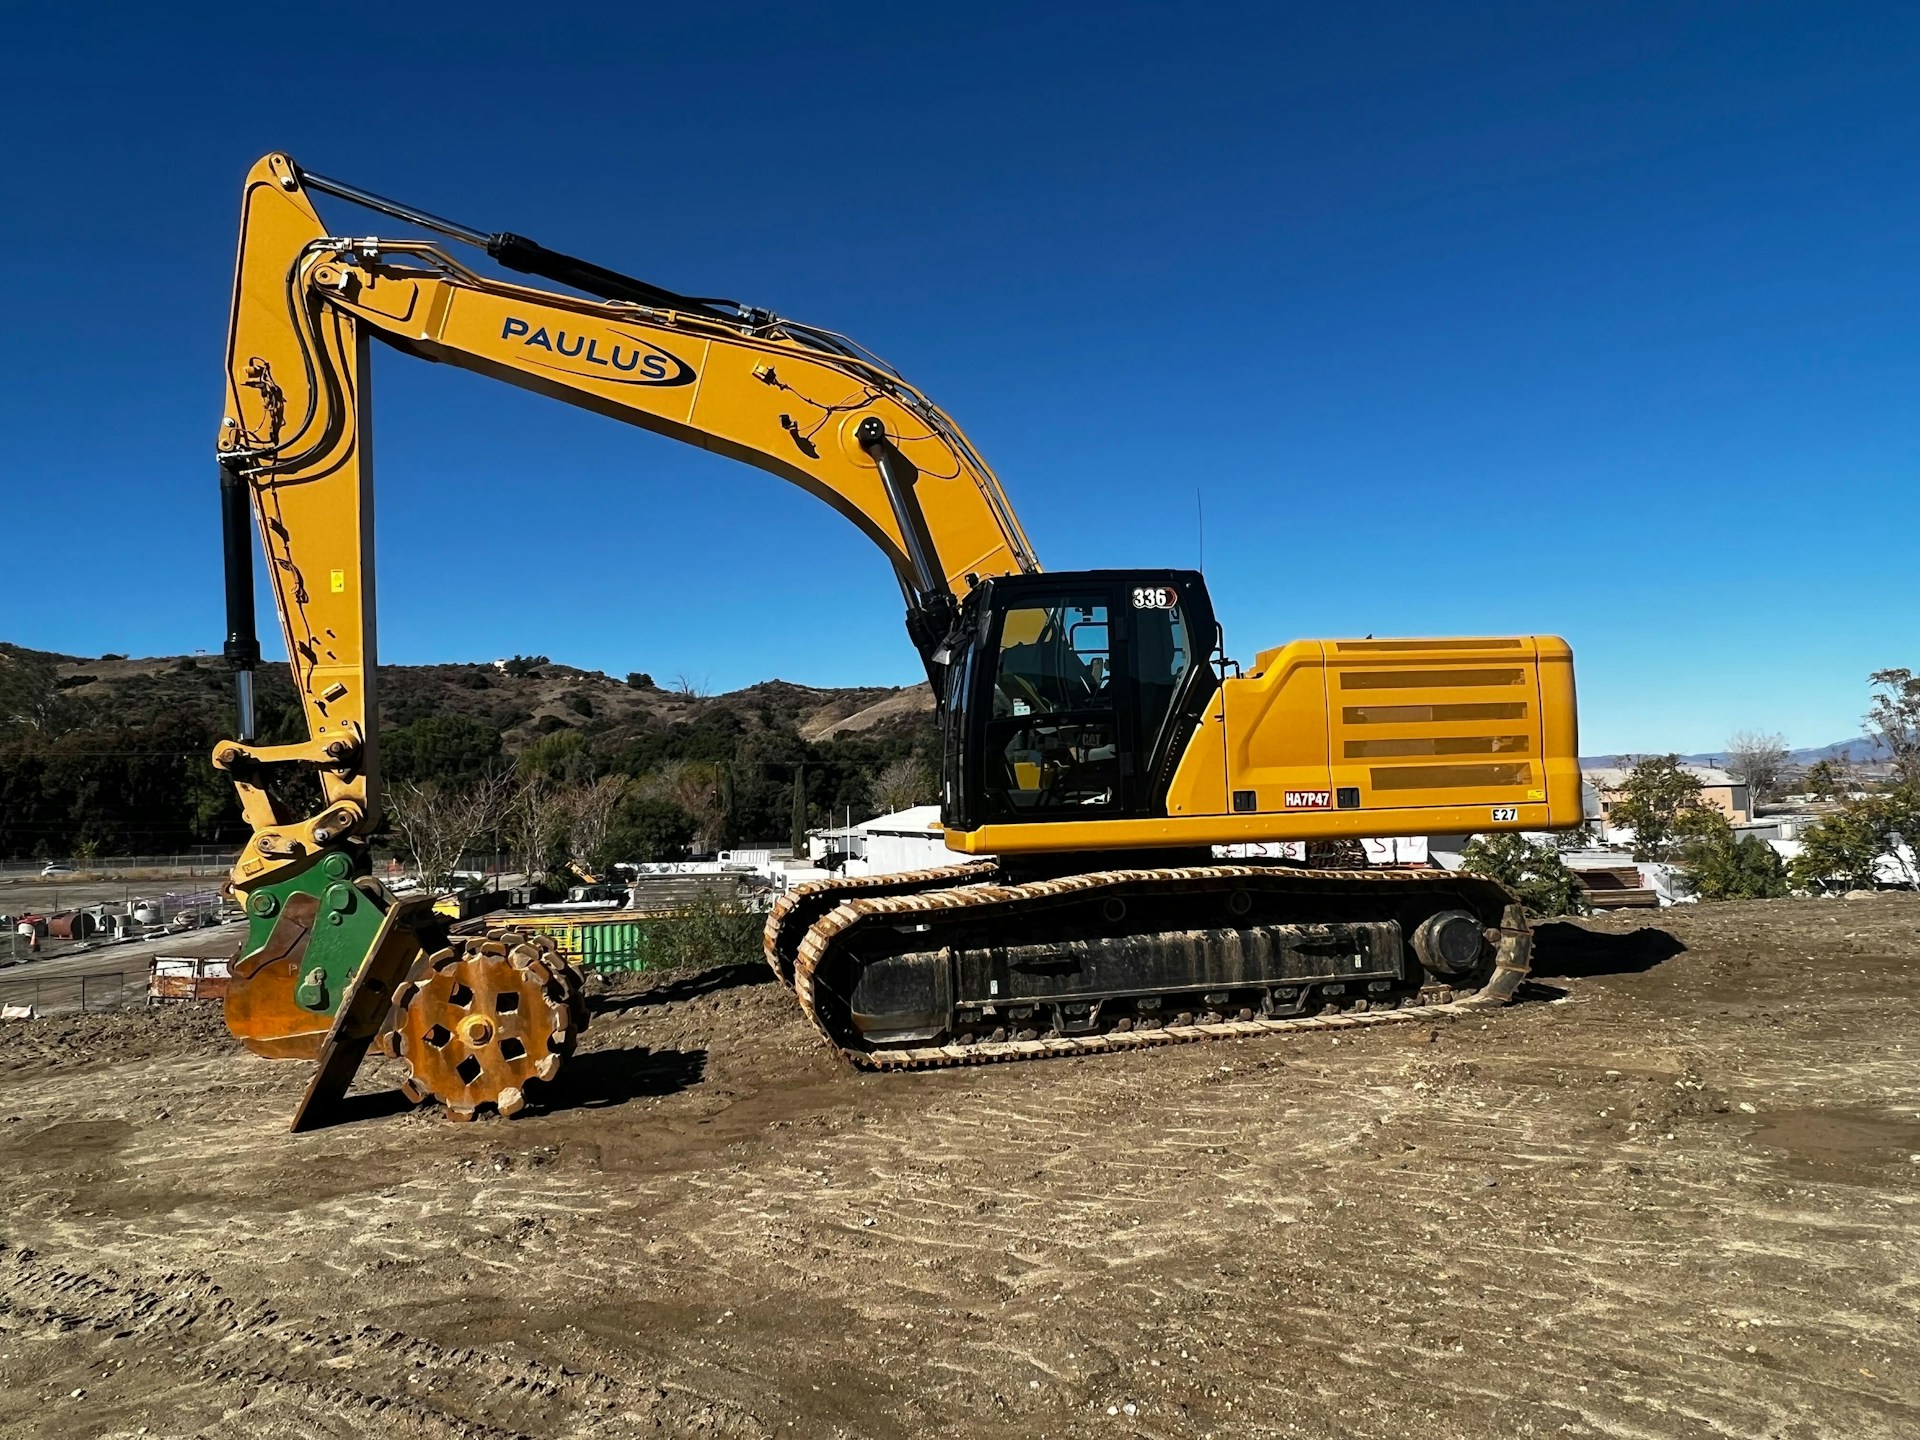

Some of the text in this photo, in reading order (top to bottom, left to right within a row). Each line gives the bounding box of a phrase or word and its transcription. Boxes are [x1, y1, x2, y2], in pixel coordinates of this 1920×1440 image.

[501, 317, 668, 379] PAULUS
[1133, 588, 1167, 607] 336
[1285, 792, 1330, 806] HA7P47
[1492, 808, 1516, 821] E27
